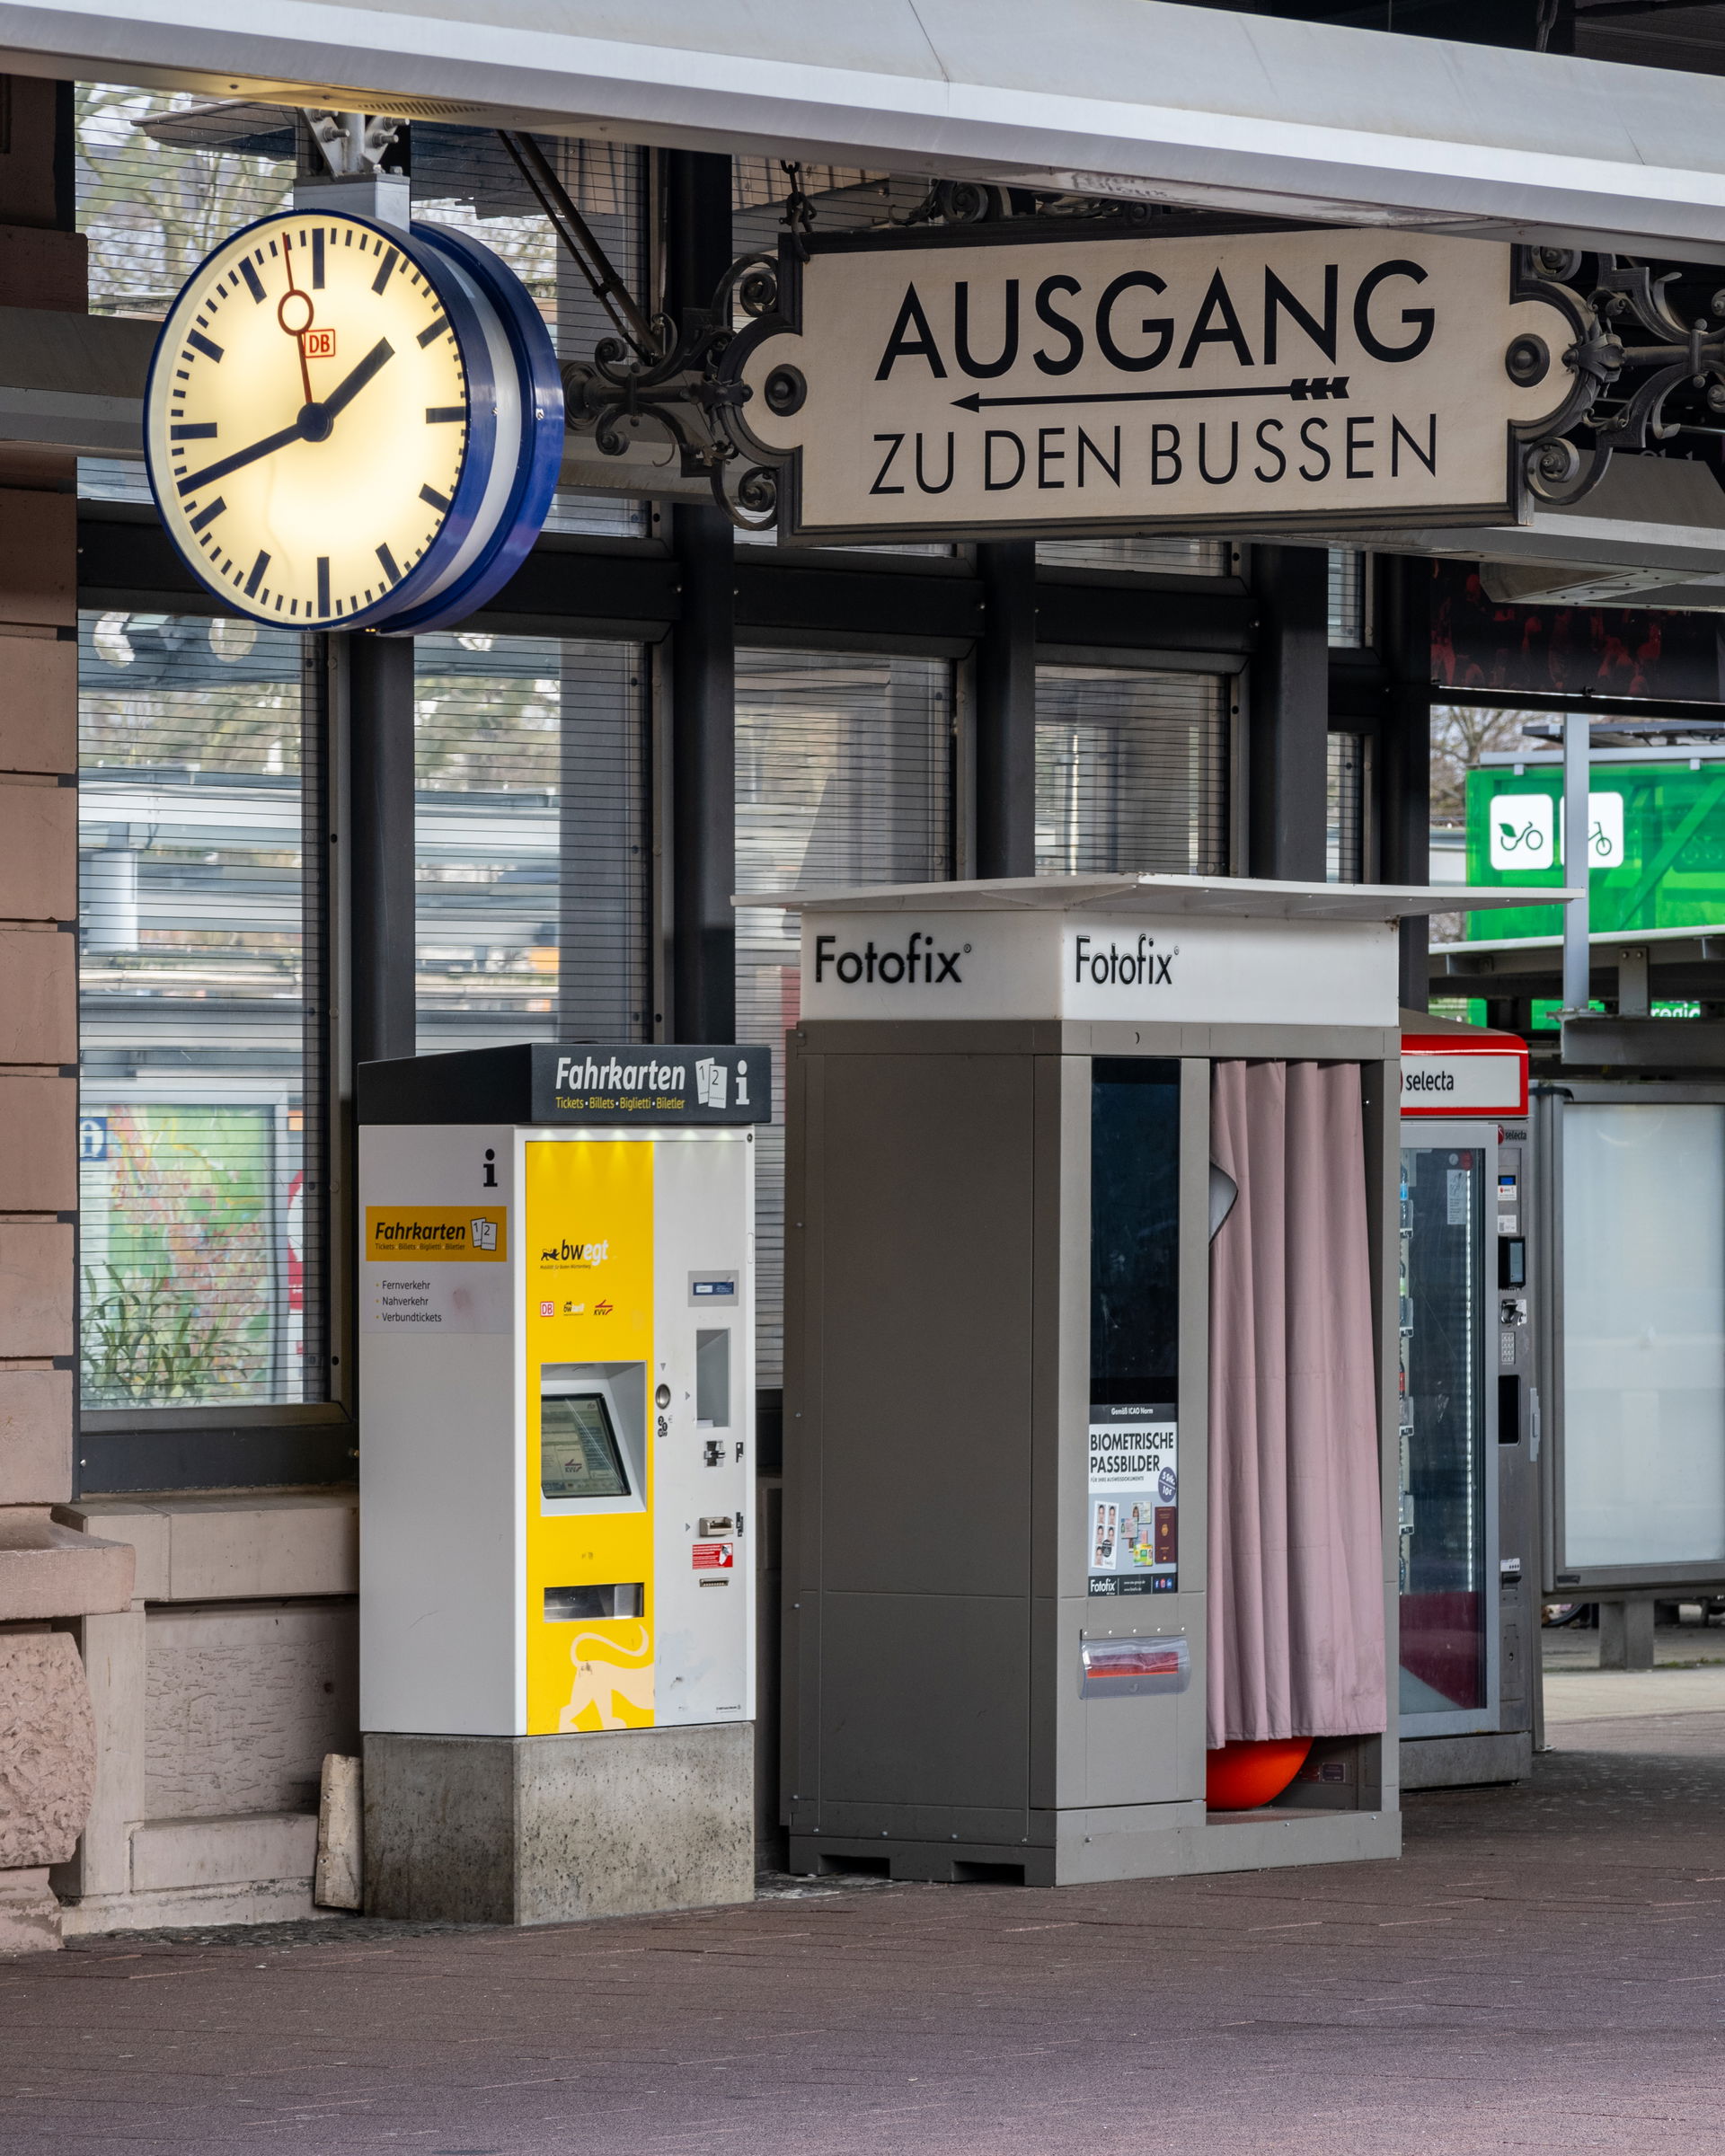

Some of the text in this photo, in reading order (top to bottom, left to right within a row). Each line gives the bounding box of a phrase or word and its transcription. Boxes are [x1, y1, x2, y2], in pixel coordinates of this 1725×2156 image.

[874, 259, 1436, 381] AUSGANG
[309, 333, 330, 353] DB
[869, 413, 1437, 495] ZU DEN BUSSEN
[555, 1056, 686, 1091] Fahrkarten
[1405, 1071, 1454, 1091] selecta
[556, 1097, 686, 1112] Tickets Billets Biglietti Biletler
[1505, 1129, 1526, 1140] selecta
[376, 1222, 465, 1241] Fahrkarten
[561, 1239, 609, 1267] bwegt
[382, 1280, 431, 1290] Fernverkehr
[382, 1295, 429, 1306] Nahverkehr
[542, 1304, 552, 1314] DB
[382, 1312, 442, 1322] Verbundtickets
[1090, 1432, 1173, 1451] BIOMETRISCHE
[1090, 1454, 1160, 1473] PASSBILDER
